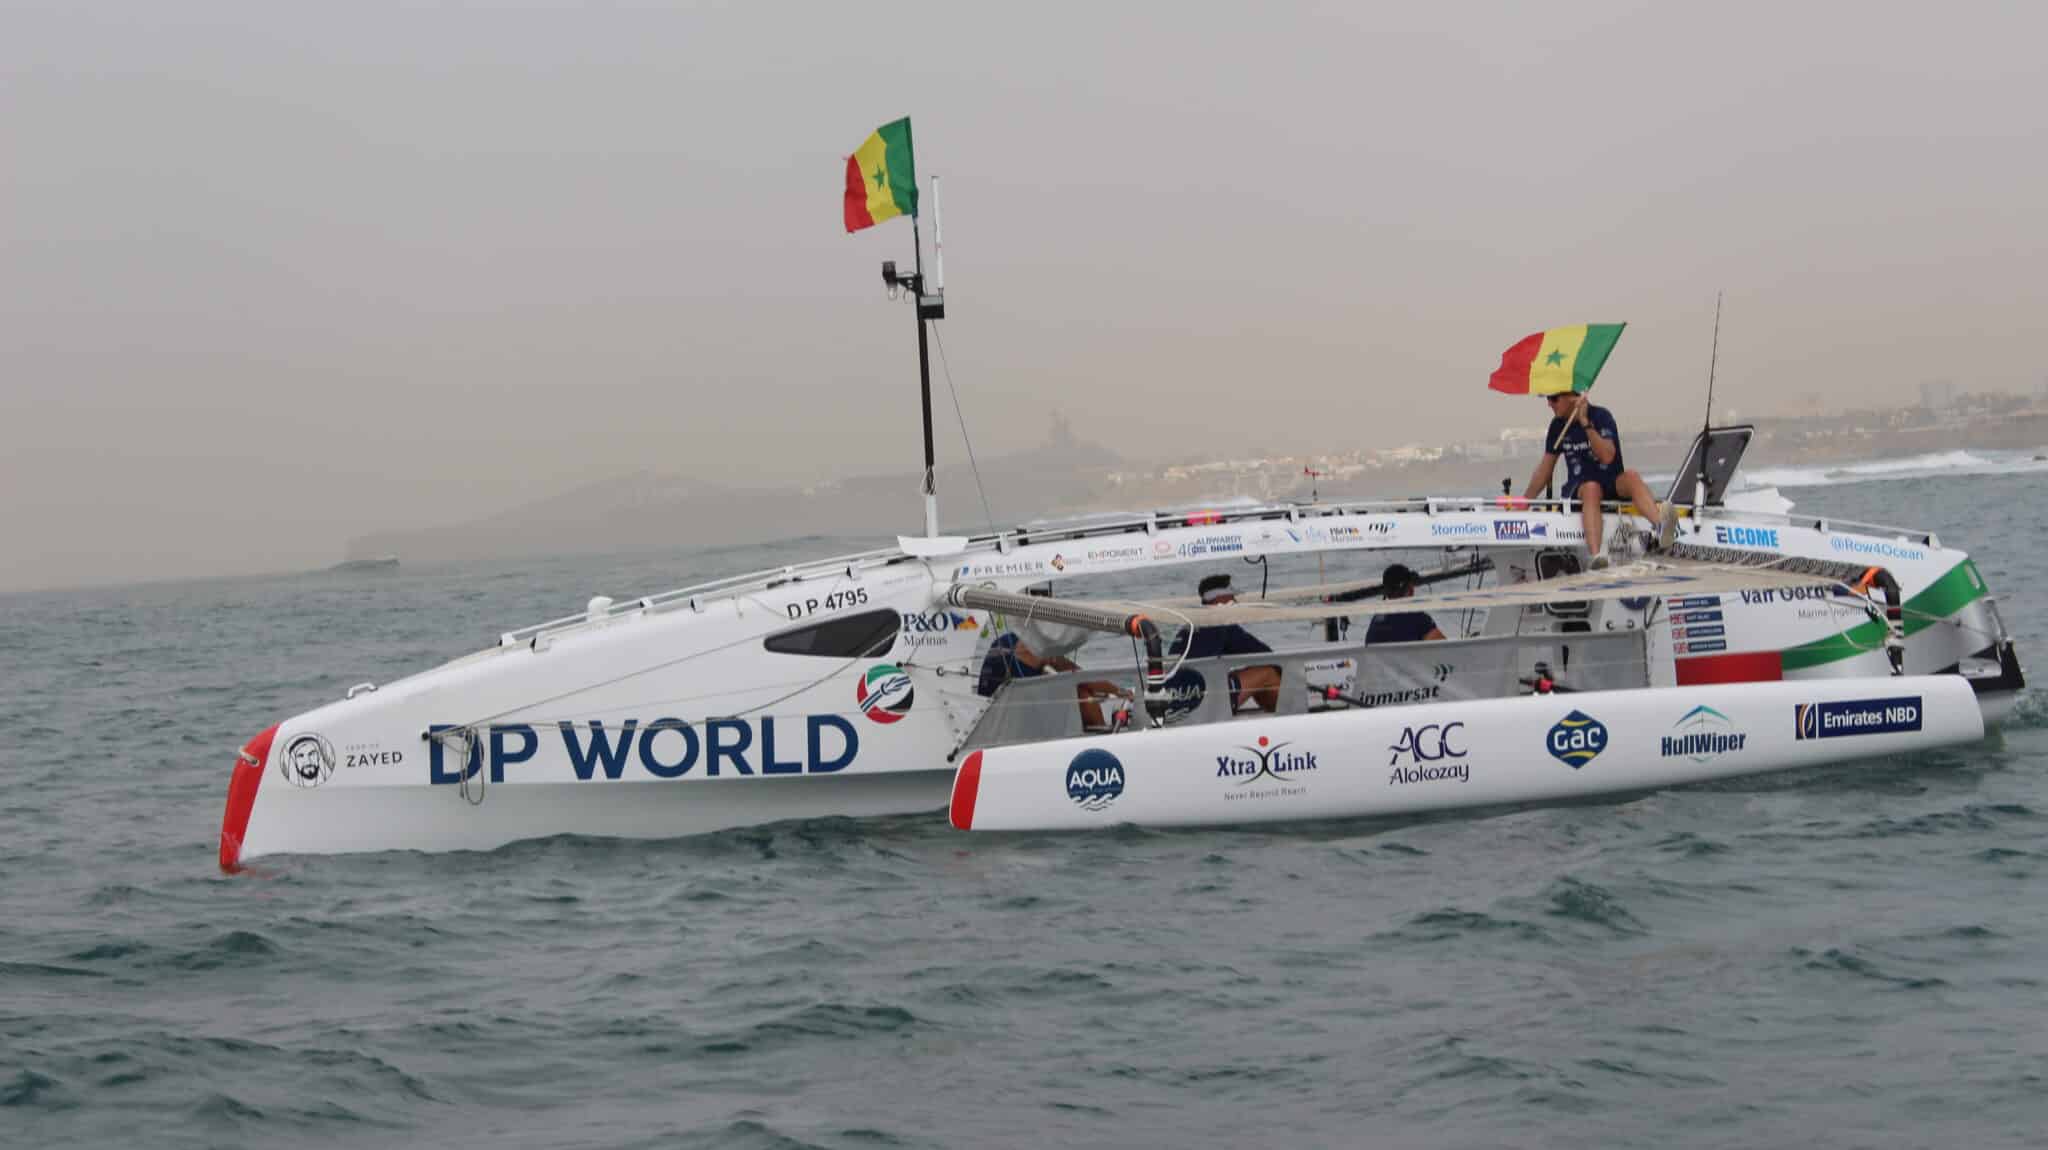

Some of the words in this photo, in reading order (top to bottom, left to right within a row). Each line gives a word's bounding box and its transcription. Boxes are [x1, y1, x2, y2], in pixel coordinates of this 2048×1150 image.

[1431, 521, 1488, 537] StormGeo
[1715, 525, 1780, 548] ELCOME
[973, 560, 1044, 576] PREMIER
[824, 587, 869, 611] 4795
[903, 611, 949, 633] P&O
[1359, 685, 1440, 706] inmarsat
[1823, 709, 1883, 729] Emirates
[1885, 706, 1918, 724] NBD
[429, 723, 539, 786] DP
[557, 713, 860, 781] WORLD
[1388, 721, 1468, 766] AGC
[1660, 731, 1748, 757] HullWiper
[346, 751, 403, 769] ZAYED
[1216, 755, 1256, 777] Xtra
[1273, 751, 1318, 773] Link
[1070, 766, 1122, 792] AQUA
[1390, 763, 1470, 785] Alokozay
